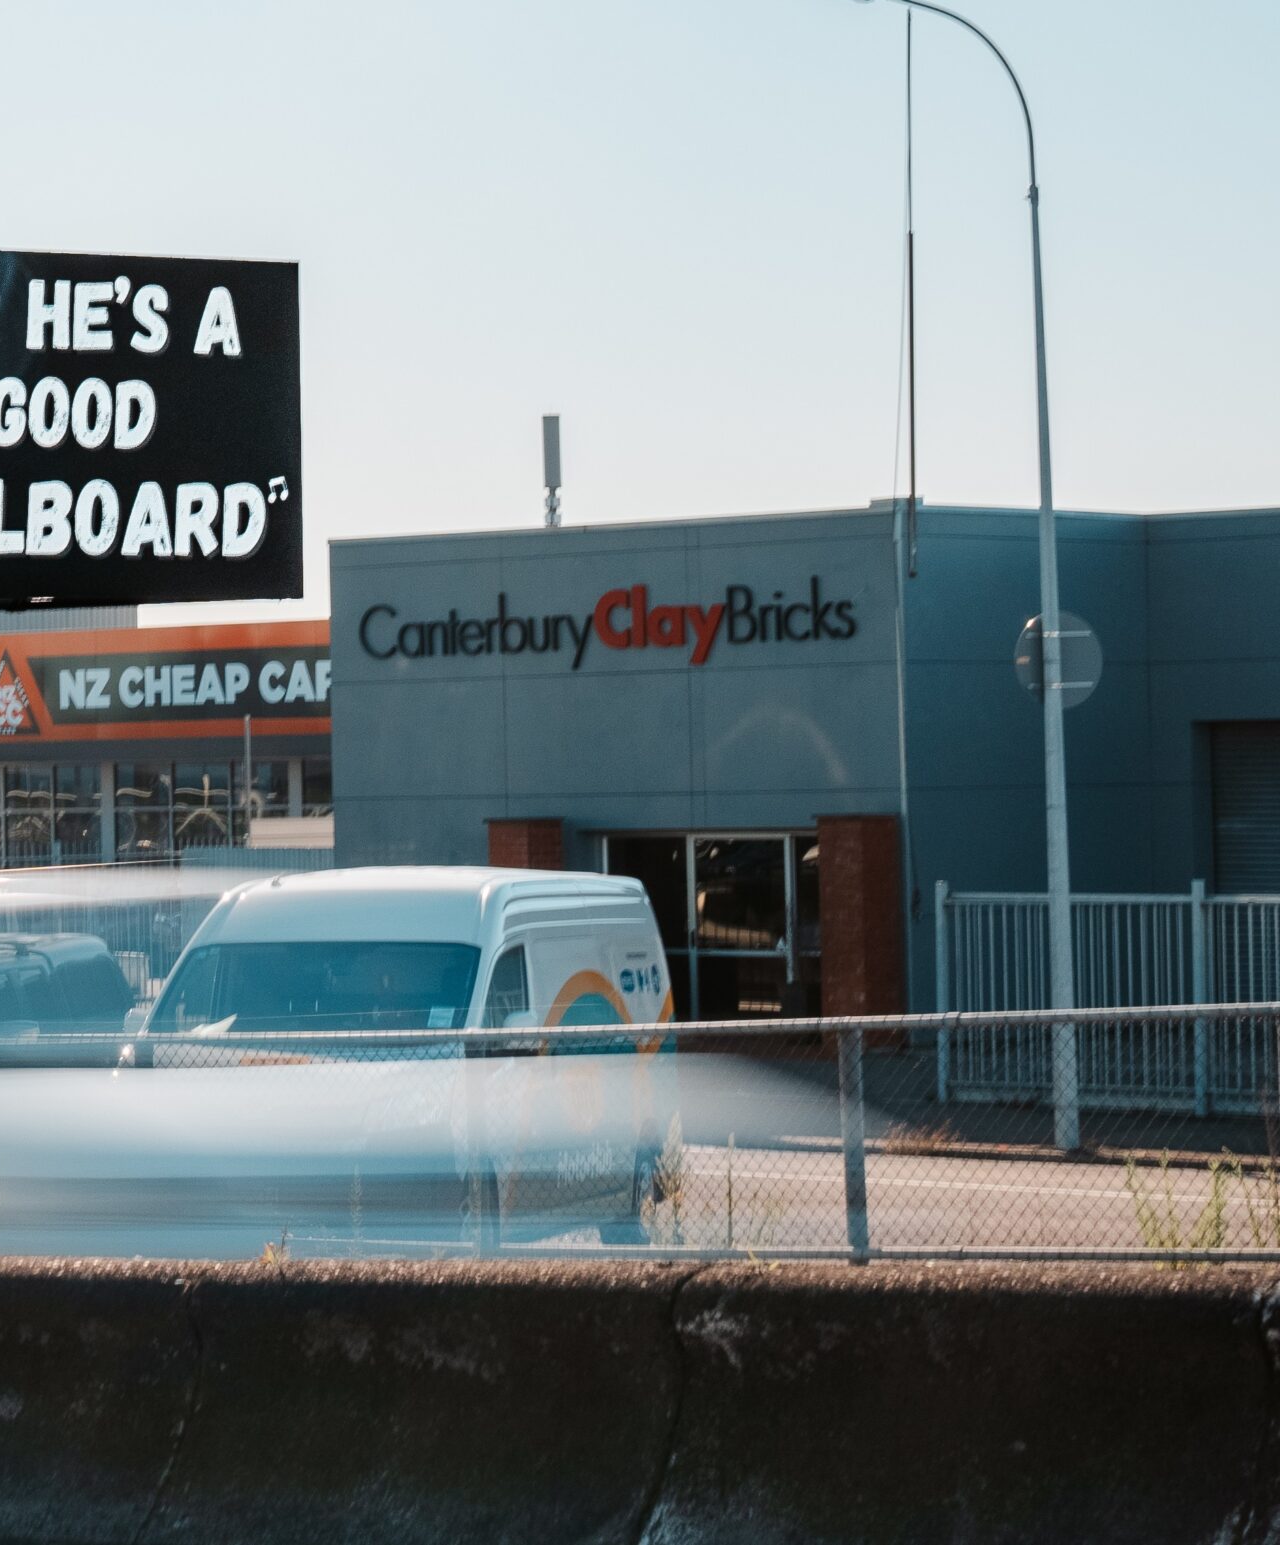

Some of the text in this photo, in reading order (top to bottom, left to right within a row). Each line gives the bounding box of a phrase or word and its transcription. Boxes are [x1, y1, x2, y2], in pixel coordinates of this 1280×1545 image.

[25, 276, 169, 353] HE'S
[193, 286, 242, 356] A
[60, 667, 111, 710] NZ
[118, 663, 250, 708] CHEAP
